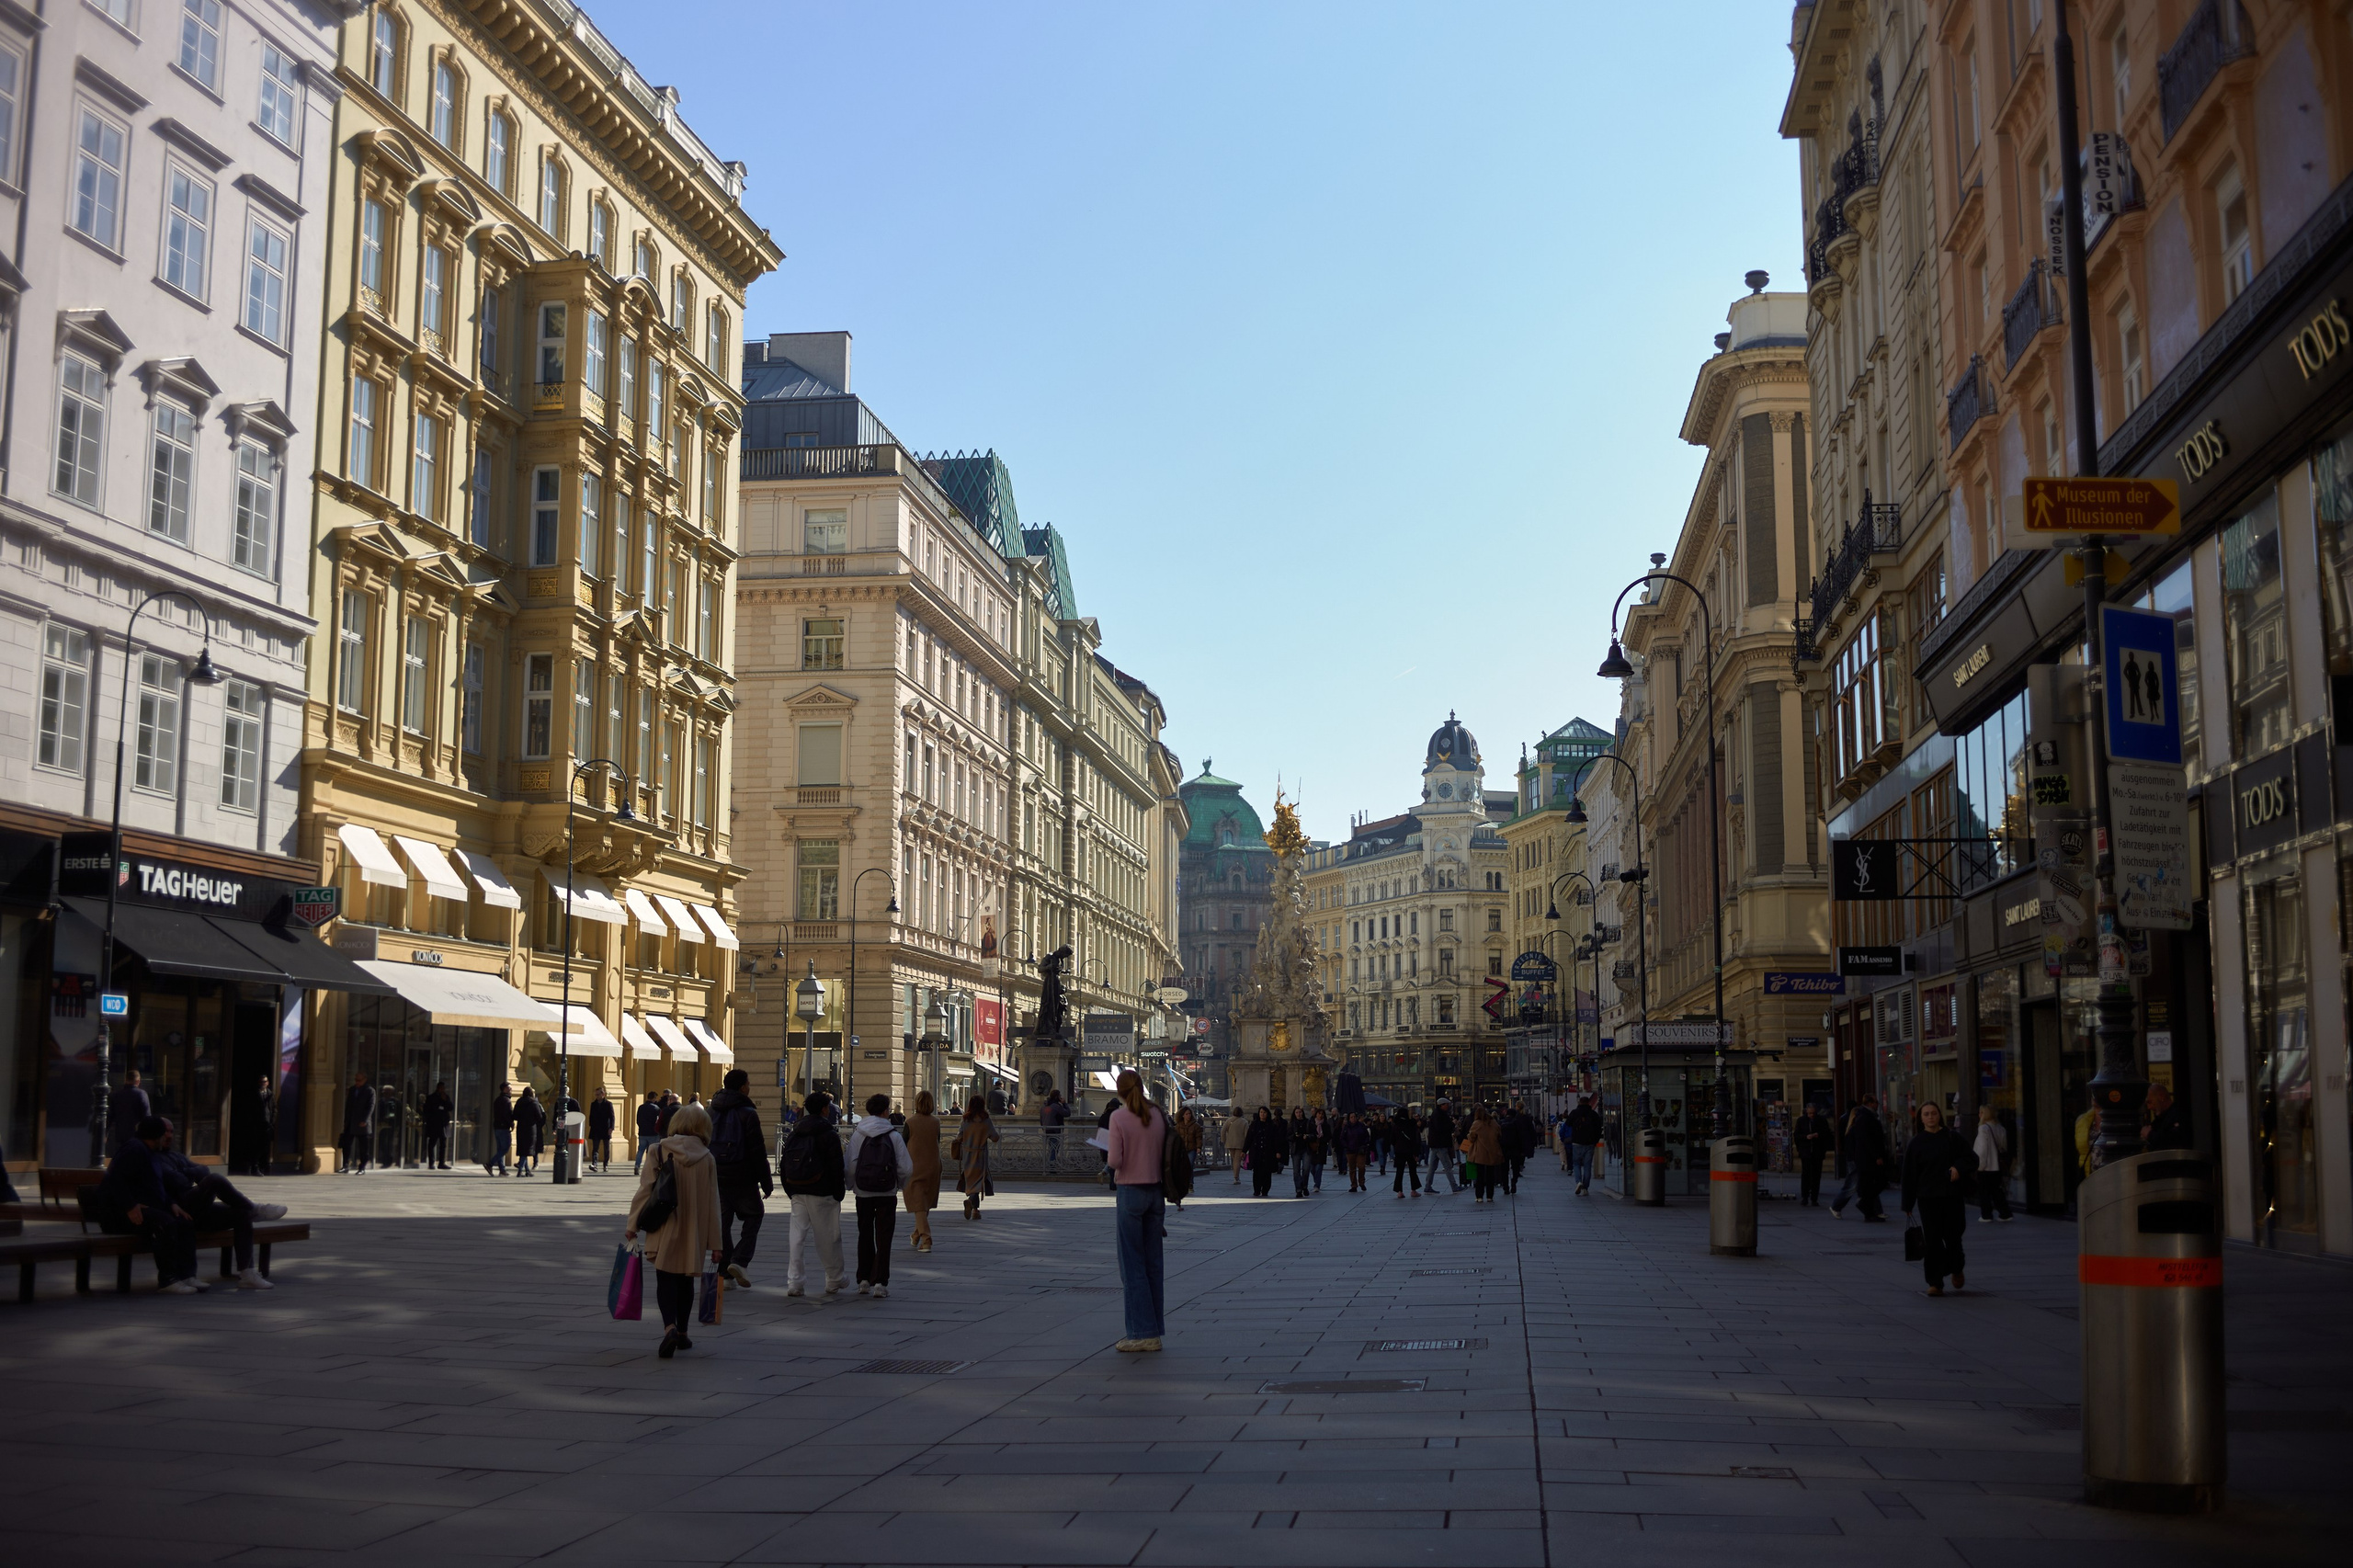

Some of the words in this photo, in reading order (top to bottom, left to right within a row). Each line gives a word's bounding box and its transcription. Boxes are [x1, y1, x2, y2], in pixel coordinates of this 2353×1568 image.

[2092, 132, 2114, 212] PENSION
[2050, 218, 2063, 274] NOSSEK
[2288, 300, 2349, 380] TOD'S
[2175, 420, 2223, 484] TOD'S
[2056, 486, 2120, 503] Museum
[2126, 487, 2151, 504] der
[2065, 507, 2143, 525] Illusionen
[2121, 774, 2176, 787] ausgenommen
[2241, 776, 2284, 828] TOD'S
[2129, 805, 2156, 817] Zufahrt
[2159, 810, 2171, 818] zur
[2120, 821, 2166, 835] Ladetätigkeit
[2169, 825, 2181, 835] mit
[2118, 838, 2159, 852] Fahrzeugen
[64, 858, 99, 869] ERSTE
[298, 891, 332, 902] TAG
[296, 904, 332, 922] HEUER
[2006, 904, 2020, 926] SAINT
[1790, 978, 1841, 991] Tchibo
[1087, 1035, 1129, 1044] BRAMO
[1648, 1028, 1716, 1038] SOUVENIRS
